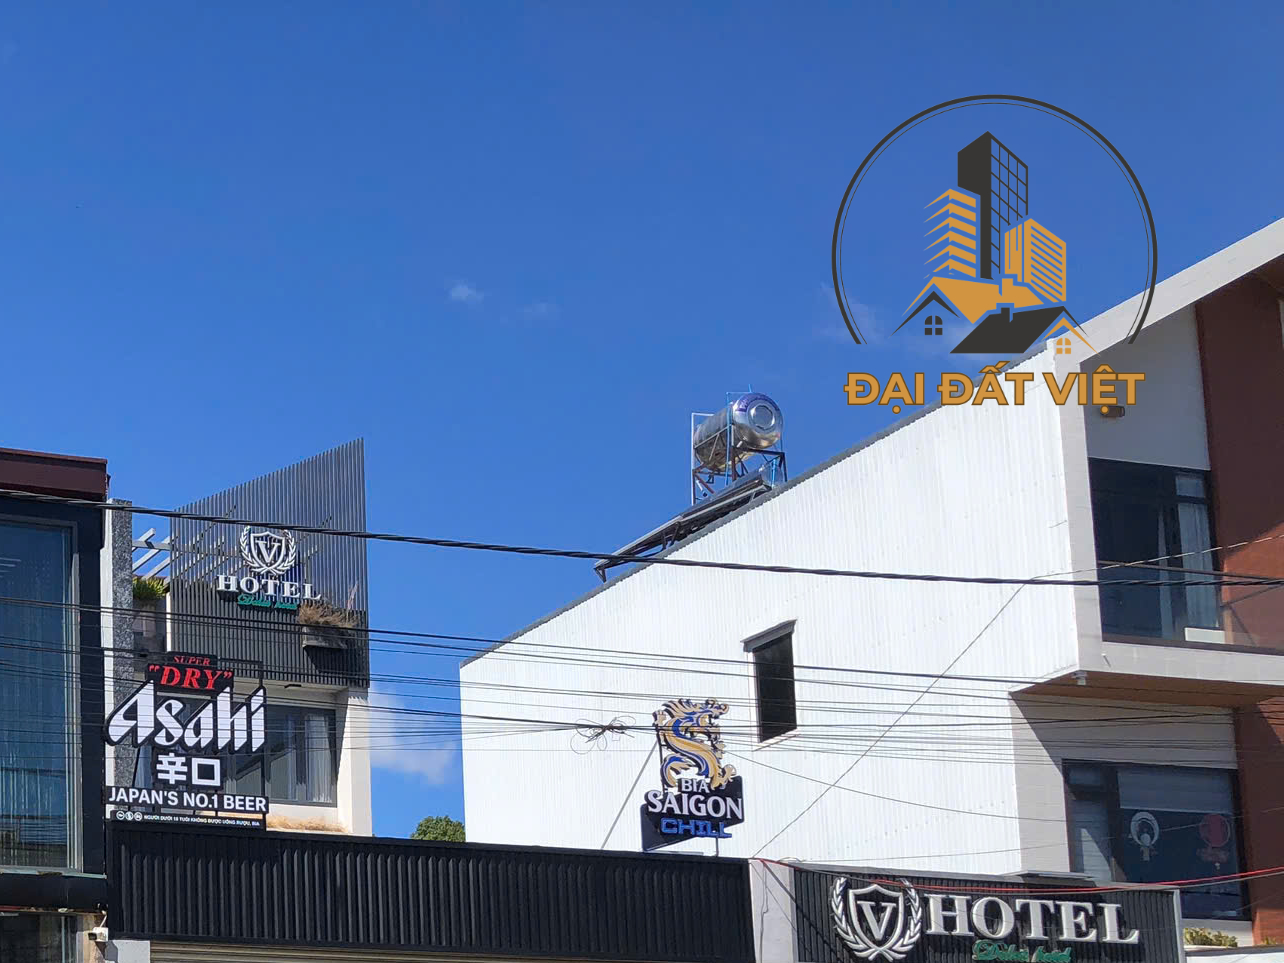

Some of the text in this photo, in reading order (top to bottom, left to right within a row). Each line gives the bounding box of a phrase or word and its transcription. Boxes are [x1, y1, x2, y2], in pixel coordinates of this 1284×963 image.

[216, 574, 321, 600] HOTEL
[173, 655, 211, 666] SUPER
[108, 680, 265, 752] Asahi
[156, 752, 221, 786] 辛口
[108, 787, 267, 812] JAPAN'S NO.1 BEER
[681, 777, 710, 794] BIA
[647, 789, 743, 820] SAIGON
[660, 817, 733, 839] CHILL
[857, 900, 897, 941] V
[923, 893, 1140, 945] HOTEL
